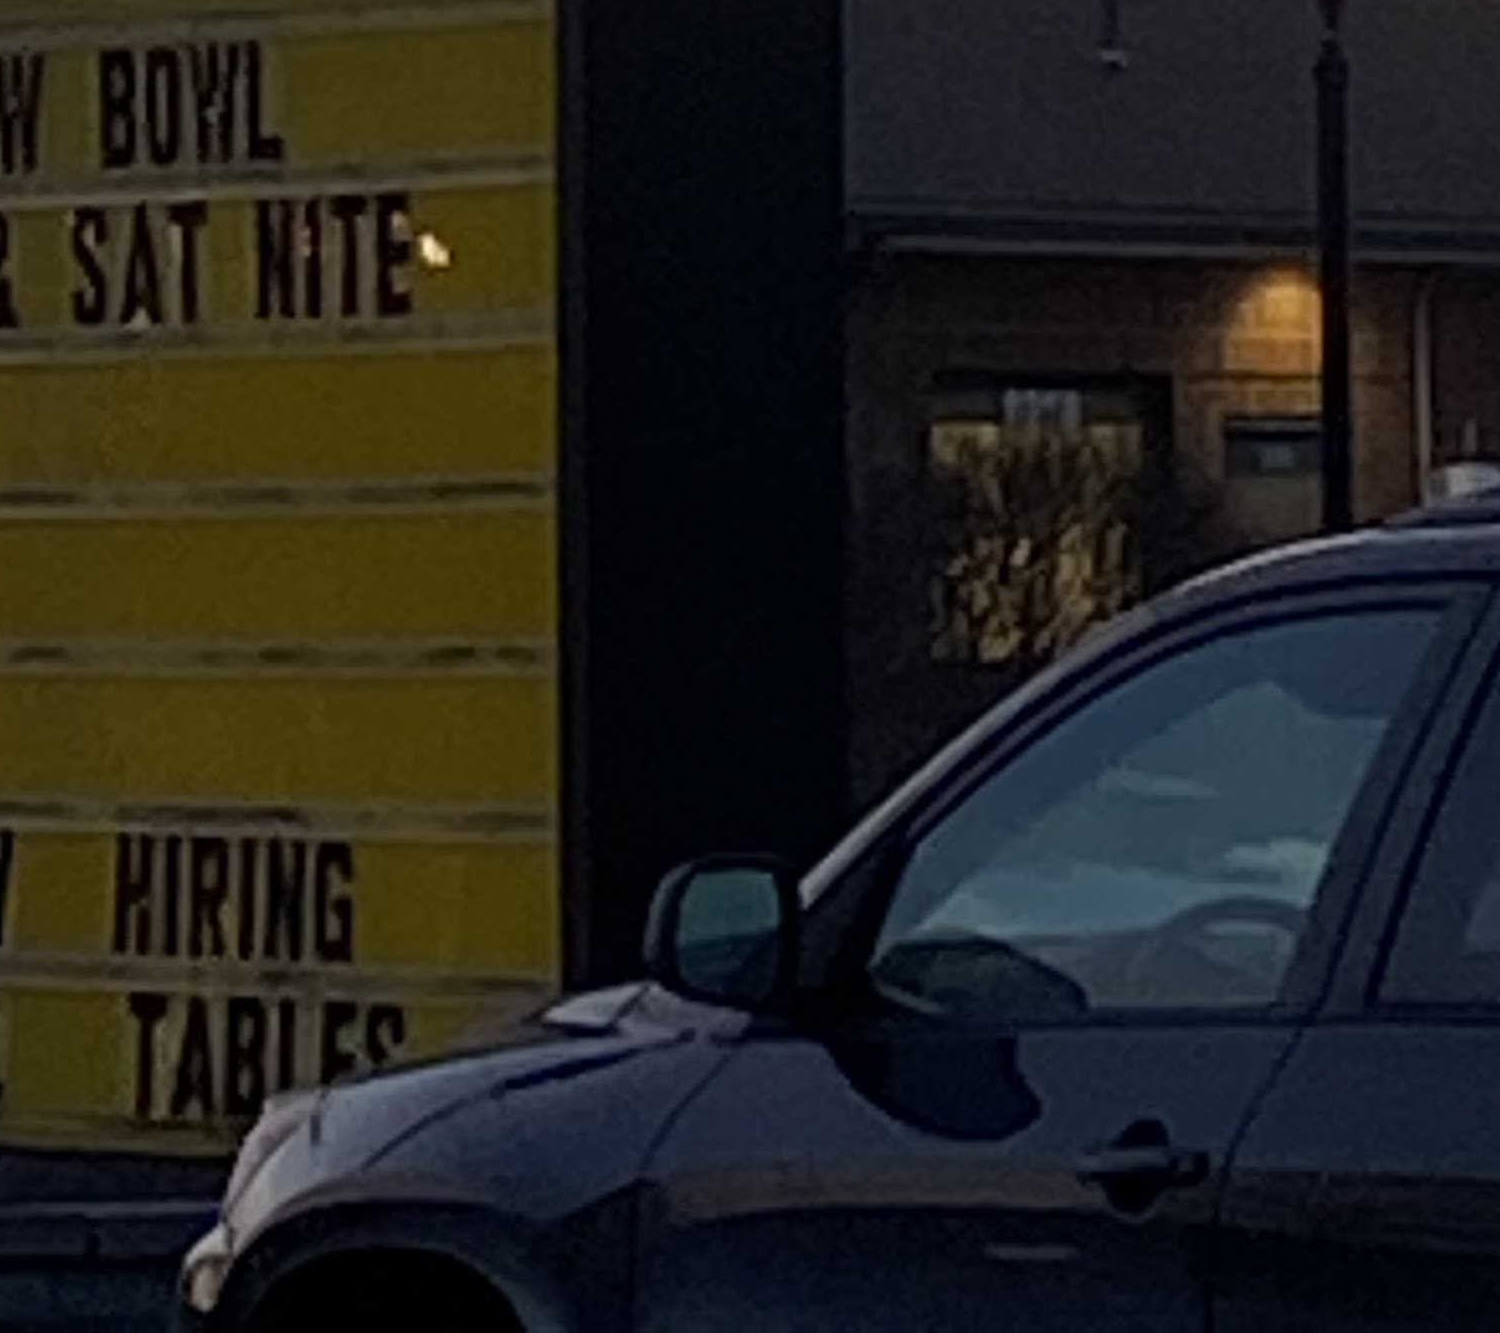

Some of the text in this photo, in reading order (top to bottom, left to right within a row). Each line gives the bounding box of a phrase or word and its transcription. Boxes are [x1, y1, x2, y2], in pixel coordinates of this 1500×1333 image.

[101, 39, 284, 167] BOWL
[72, 201, 208, 324] SAT
[254, 194, 412, 320] NITE
[114, 832, 355, 961] HIRING
